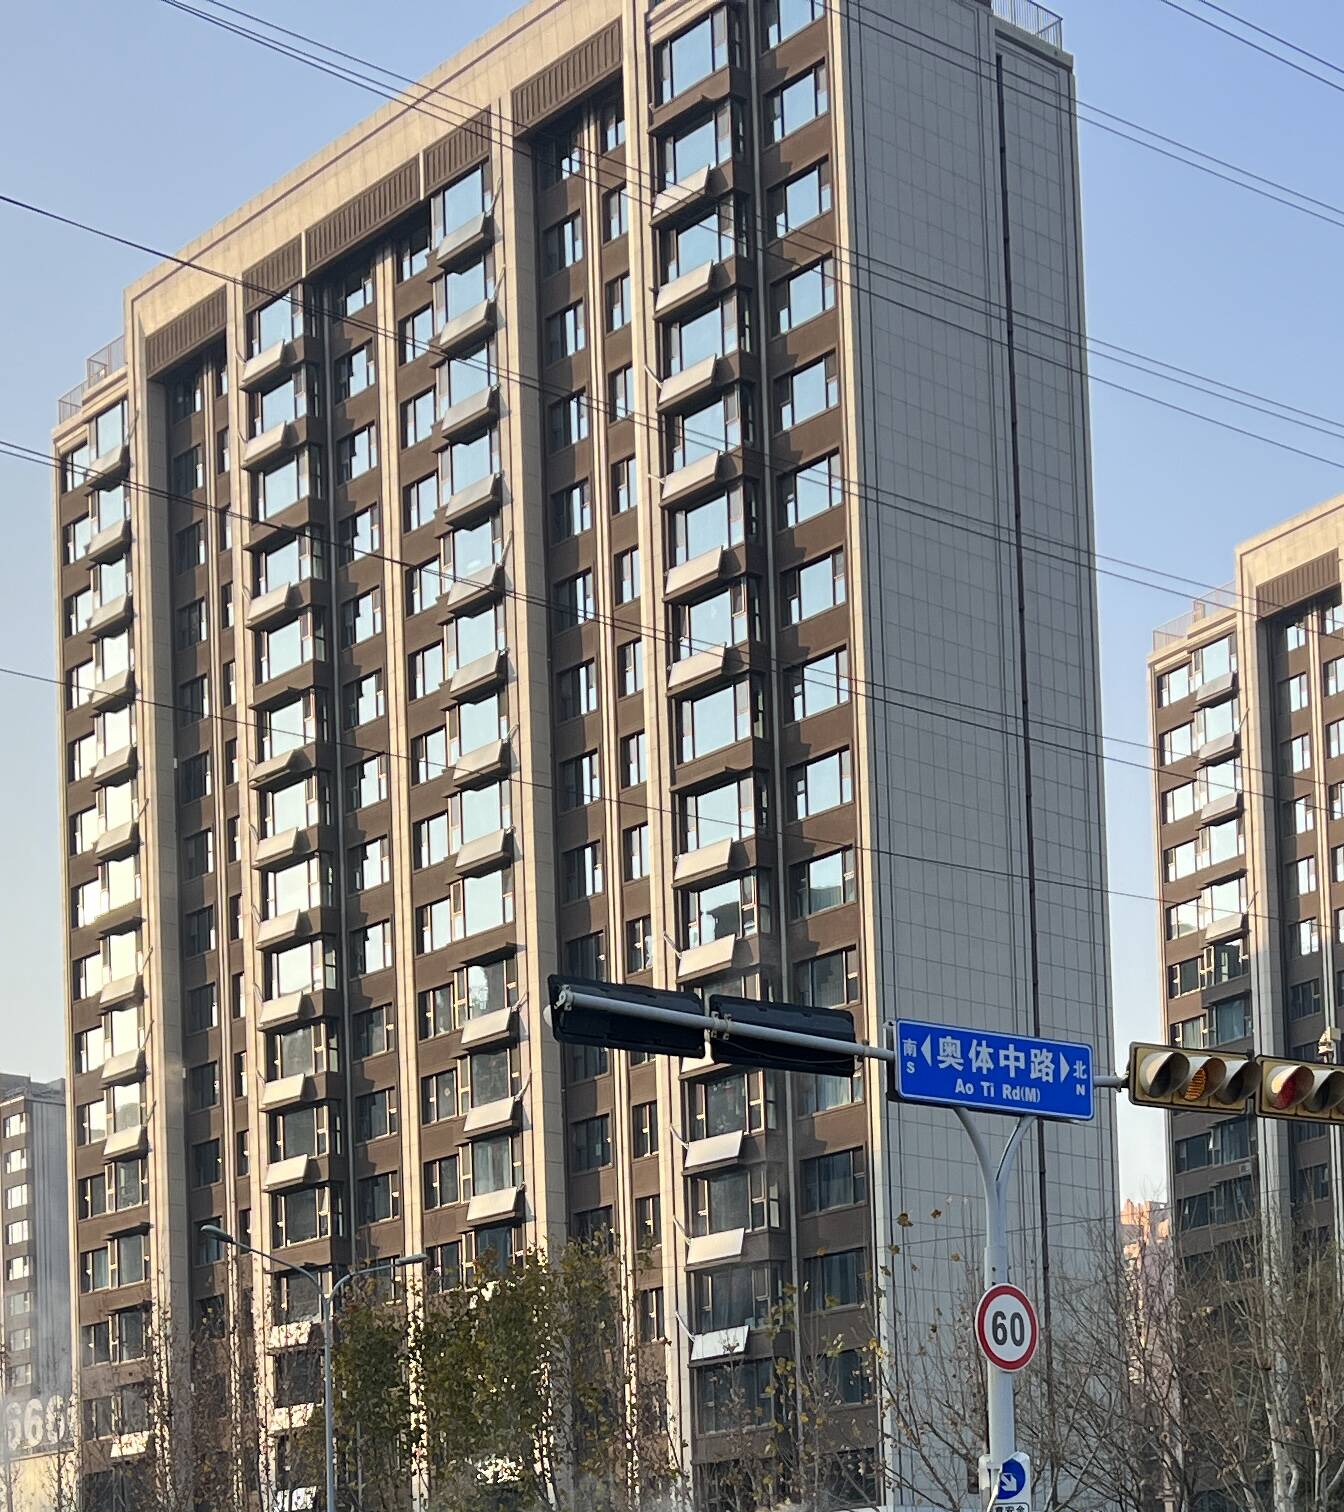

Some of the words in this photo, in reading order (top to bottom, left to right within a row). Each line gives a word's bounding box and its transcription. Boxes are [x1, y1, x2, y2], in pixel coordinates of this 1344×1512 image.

[902, 1038, 917, 1058] 南
[906, 1061, 915, 1074] S
[936, 1035, 1055, 1083] 奥体中路
[1073, 1060, 1087, 1079] 北
[955, 1078, 974, 1094] Ao
[980, 1081, 995, 1097] Ti
[1002, 1084, 1040, 1103] Rd(M)
[1075, 1084, 1086, 1096] N
[992, 1310, 1025, 1347] 60
